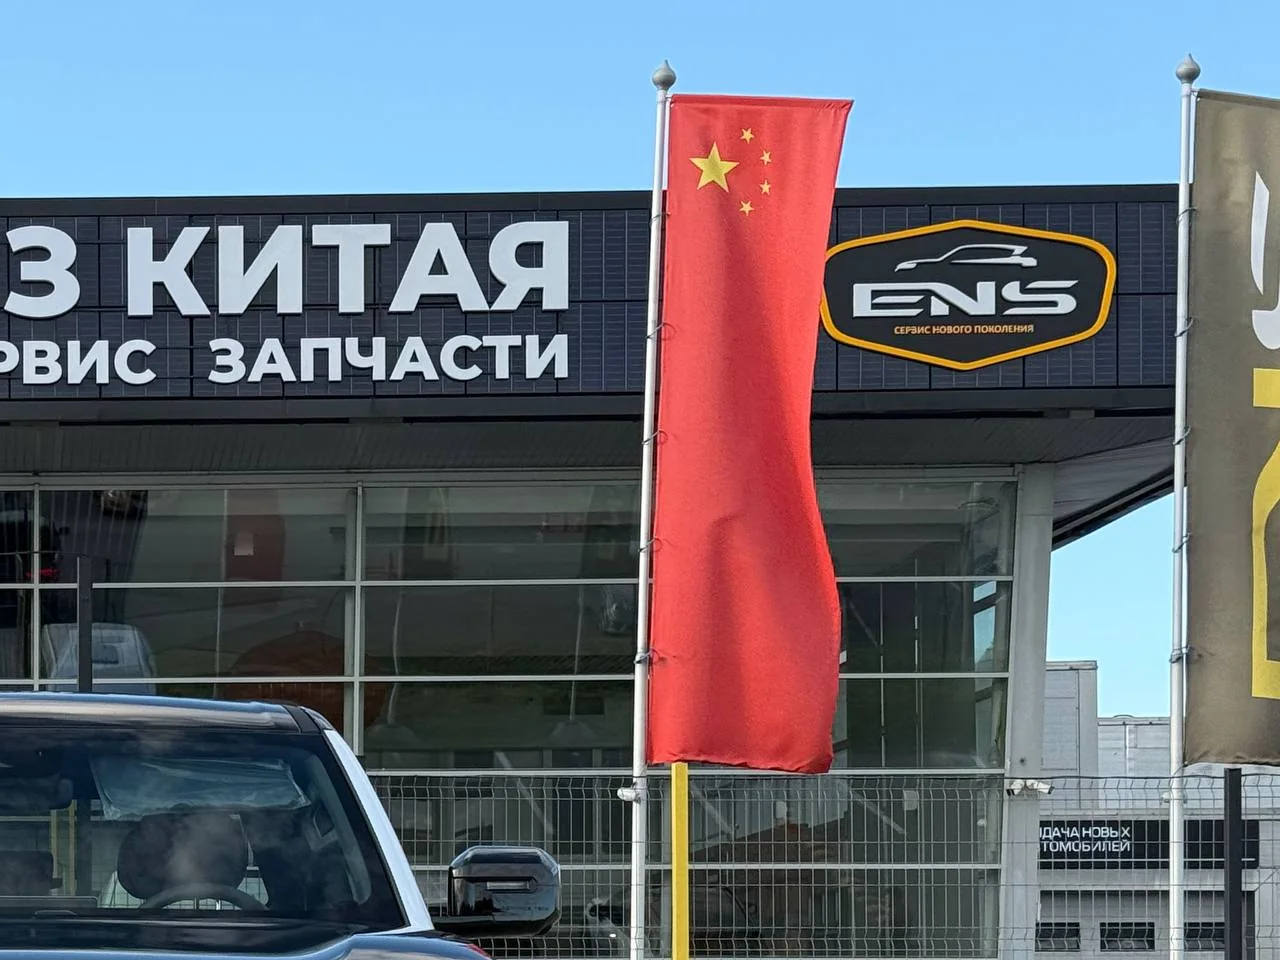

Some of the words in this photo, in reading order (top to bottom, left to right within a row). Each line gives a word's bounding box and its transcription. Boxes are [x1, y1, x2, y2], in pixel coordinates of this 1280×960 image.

[127, 220, 569, 315] КИТАЯ
[852, 280, 1079, 317] ENS
[894, 326, 931, 335] СЕРВИС
[932, 325, 973, 335] НОВОГО
[974, 324, 1034, 334] ПОКОЛЕНИЯ
[208, 333, 569, 382] ЗАПЧАСТИ
[1040, 826, 1080, 840] ДАЧА
[1042, 839, 1130, 852] ТОМОБИЛЕЙ
